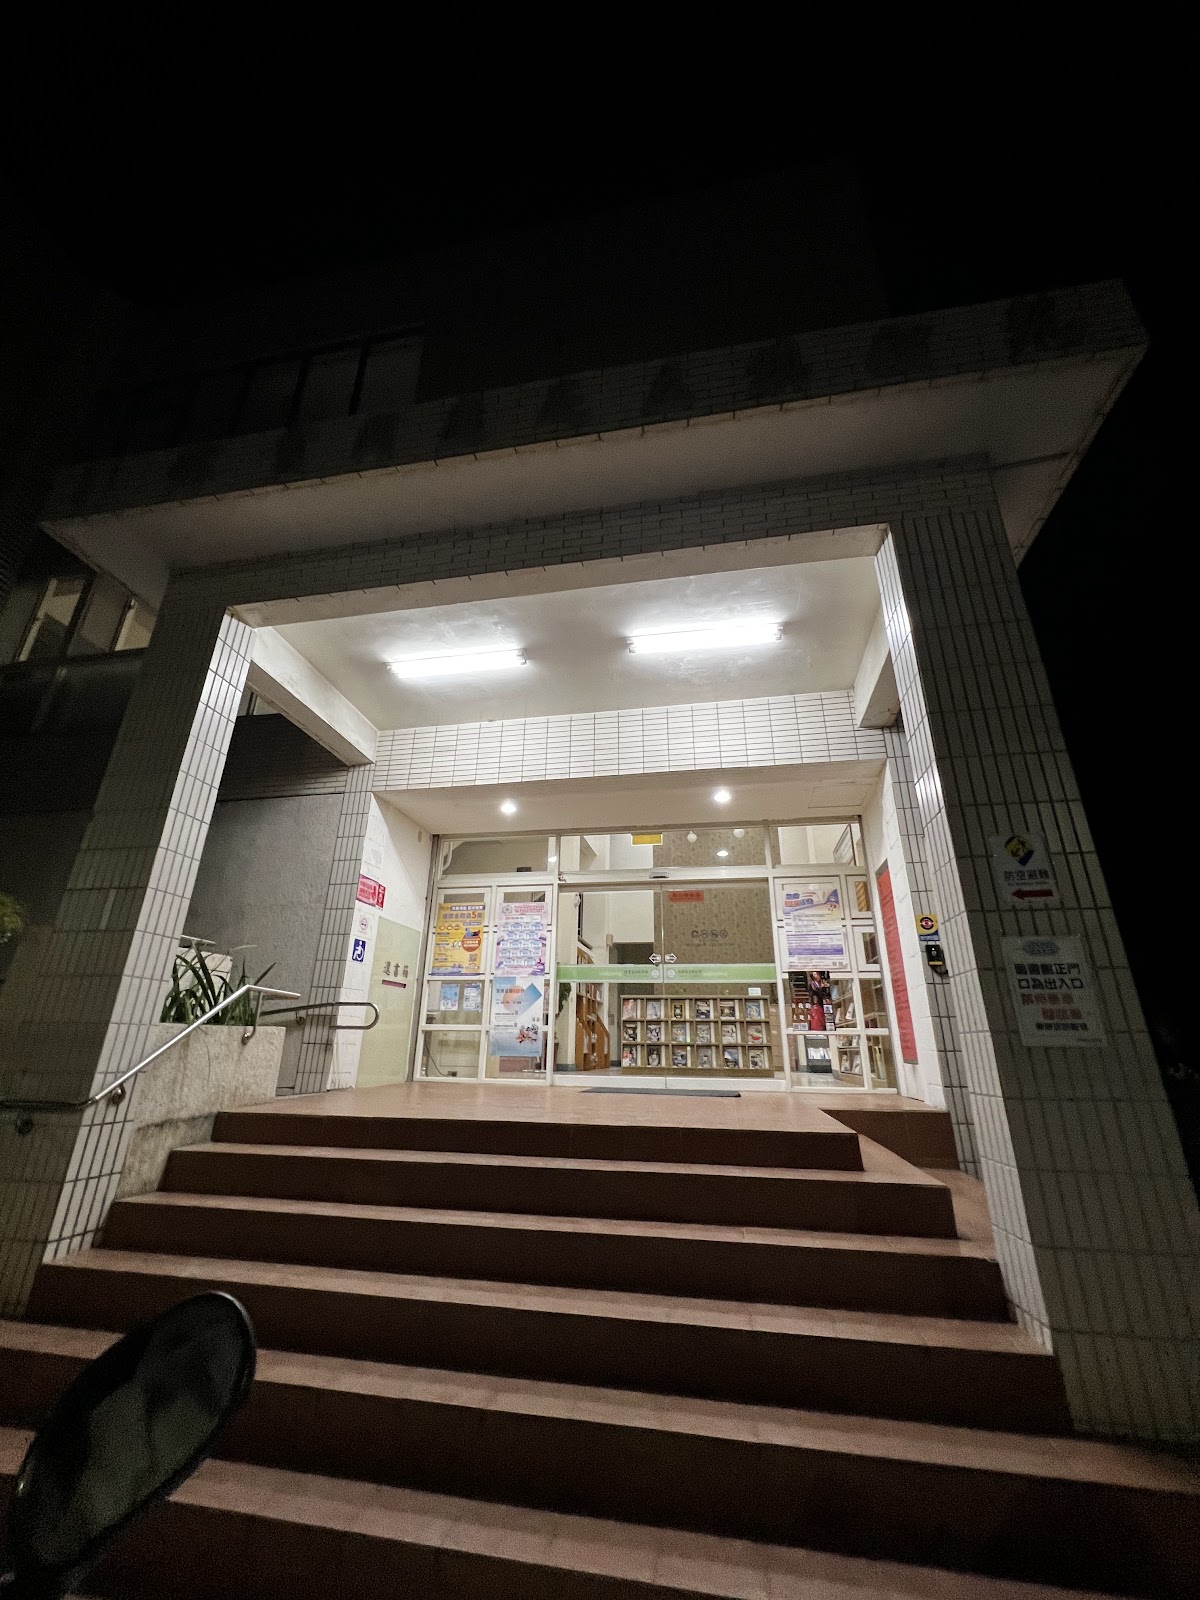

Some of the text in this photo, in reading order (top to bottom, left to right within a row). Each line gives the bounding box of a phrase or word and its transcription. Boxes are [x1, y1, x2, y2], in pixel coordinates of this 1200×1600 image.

[1004, 869, 1050, 882] 防空避難
[1017, 977, 1084, 990] 口為出入口
